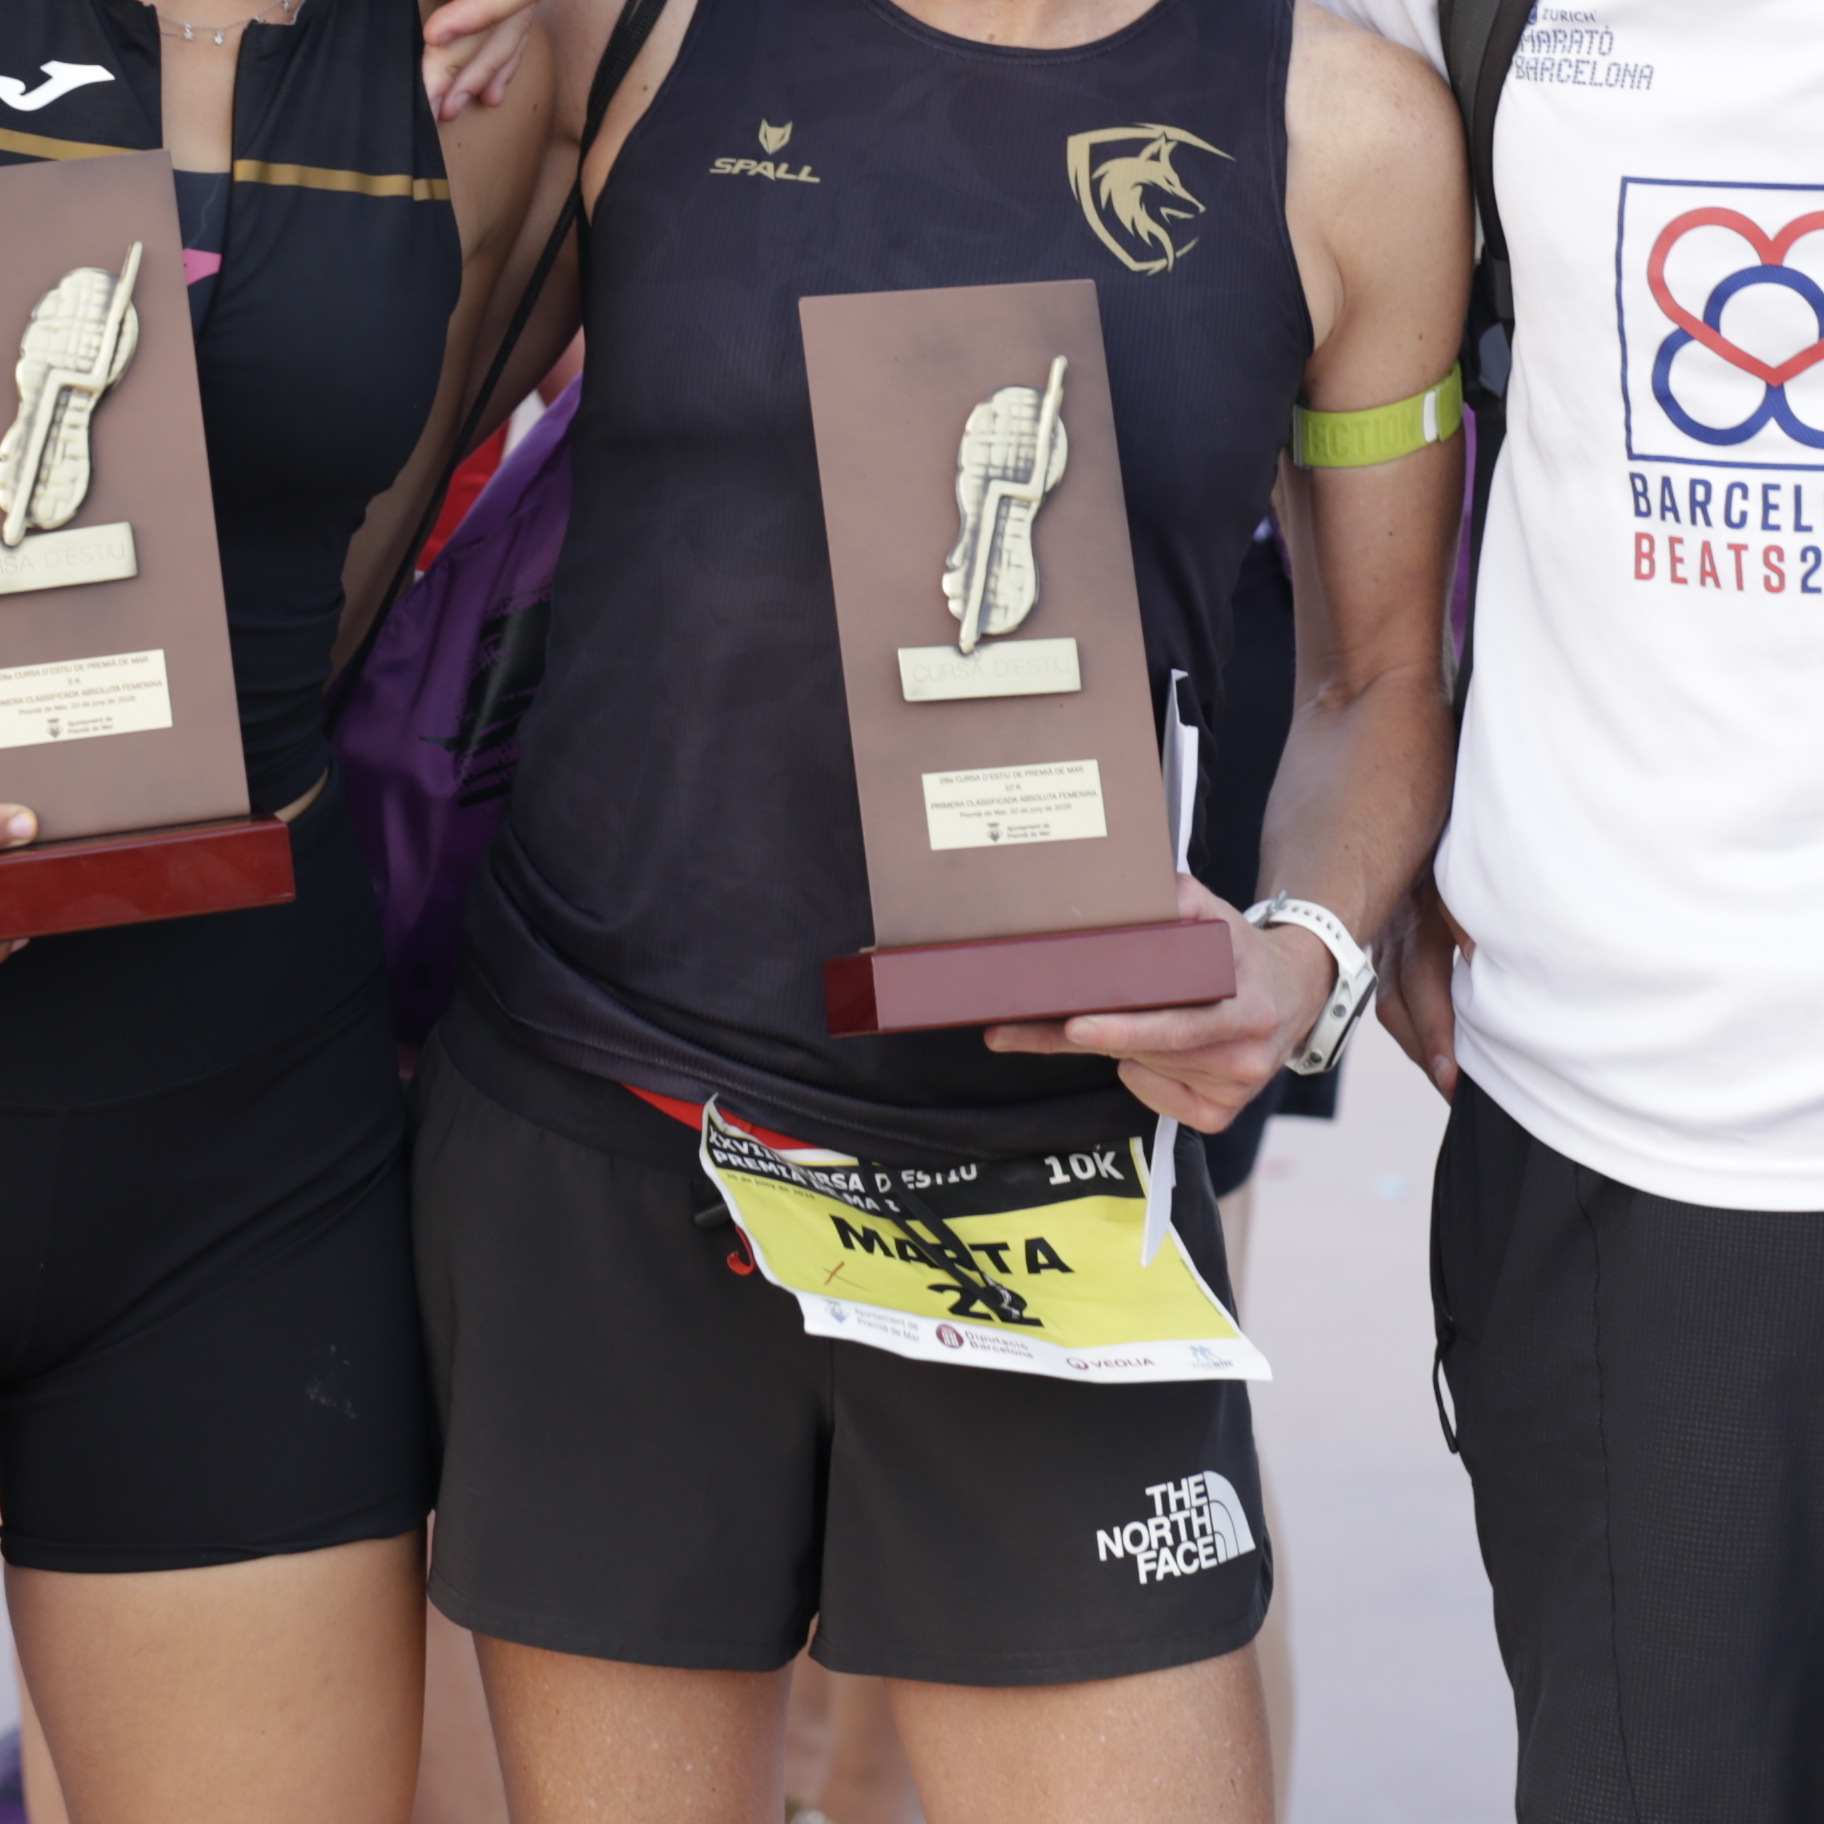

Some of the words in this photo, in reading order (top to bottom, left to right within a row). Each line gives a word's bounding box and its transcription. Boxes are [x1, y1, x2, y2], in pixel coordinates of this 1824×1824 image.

[1542, 8, 1596, 23] ZURICH
[1515, 56, 1654, 90] BARCELONA
[709, 157, 821, 183] SPALL
[14, 669, 40, 679] CURSA
[74, 663, 84, 672] DE
[118, 658, 128, 666] DE
[130, 655, 149, 664] MAR
[913, 658, 984, 683] CURSA
[81, 684, 120, 696] ABSOLUTA
[122, 680, 163, 691] FEMENINA
[1013, 770, 1022, 778] DE
[1054, 766, 1064, 775] DE
[1044, 1150, 1125, 1186] 10K
[890, 1326, 902, 1337] de
[907, 1320, 919, 1331] de
[965, 1329, 1028, 1351] Diputació
[970, 1340, 1034, 1359] Barcelona
[1090, 1357, 1156, 1369] VEOLIA
[1145, 1472, 1209, 1517] THE
[1096, 1503, 1213, 1562] NORTH
[1136, 1534, 1218, 1585] FACE
